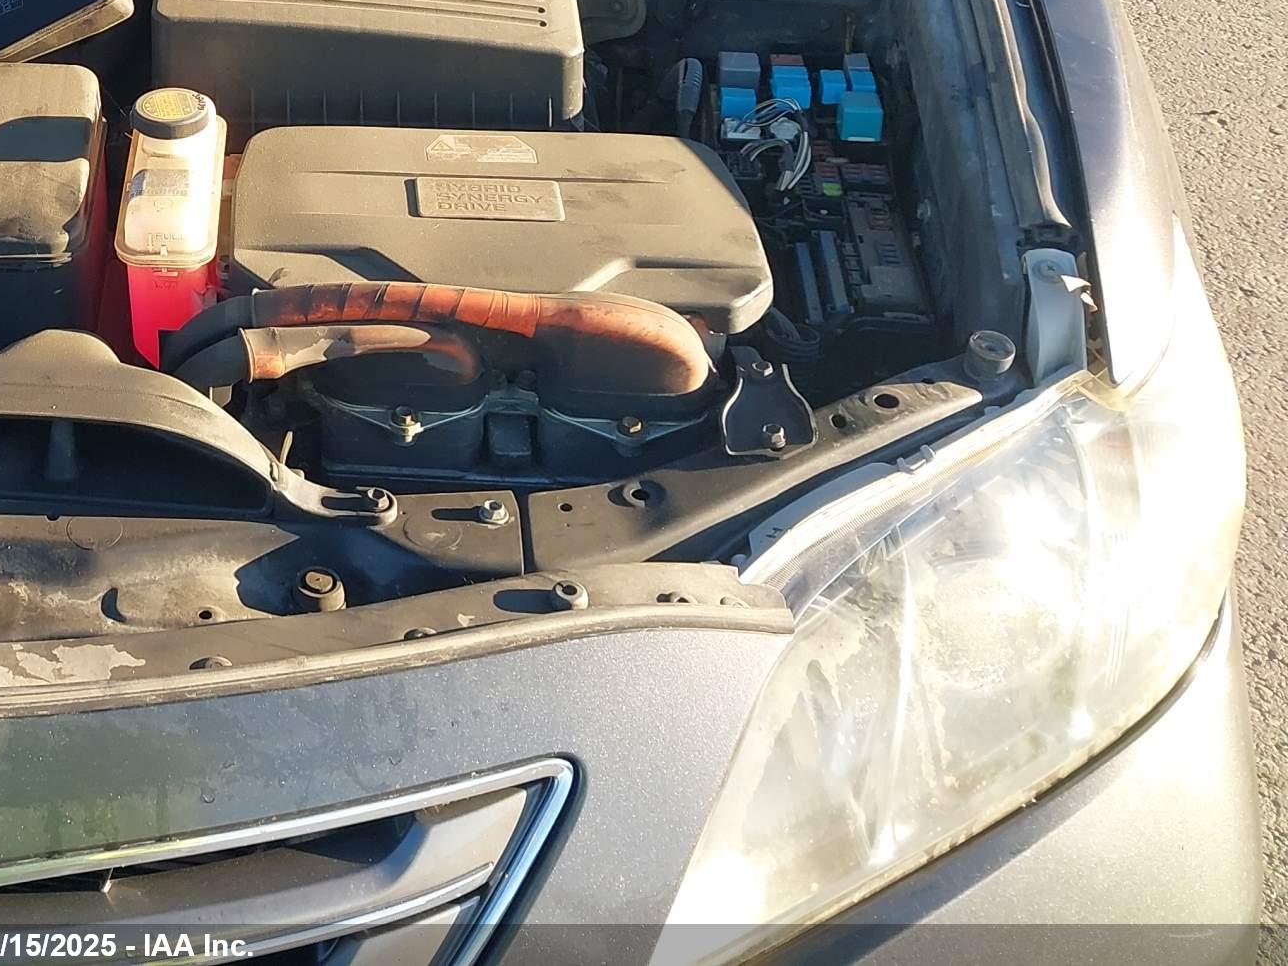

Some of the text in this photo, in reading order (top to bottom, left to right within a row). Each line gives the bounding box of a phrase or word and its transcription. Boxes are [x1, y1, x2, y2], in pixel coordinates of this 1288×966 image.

[434, 182, 521, 193] HYBRID
[436, 192, 545, 203] SYNERGY
[437, 202, 507, 211] DRIVE
